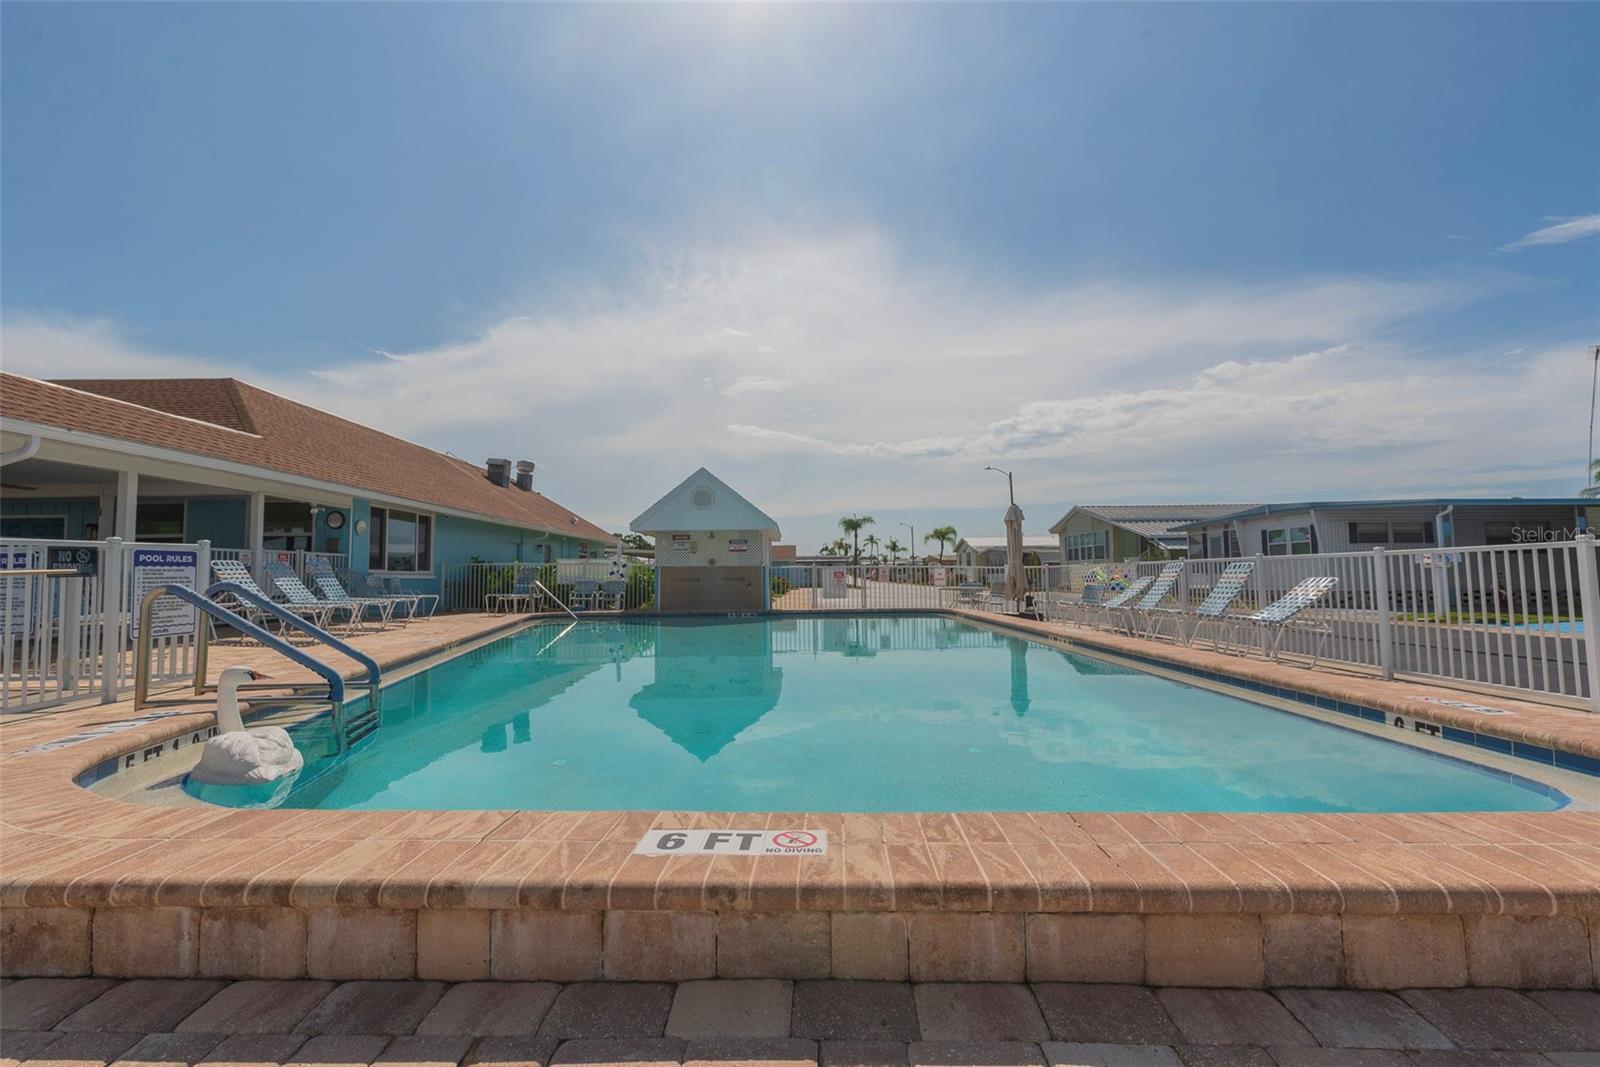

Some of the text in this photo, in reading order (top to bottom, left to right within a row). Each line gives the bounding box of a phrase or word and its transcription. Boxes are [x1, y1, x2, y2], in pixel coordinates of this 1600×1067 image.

[58, 550, 72, 562] NO
[139, 554, 193, 563] POOL RULES
[656, 832, 762, 851] 6 FT
